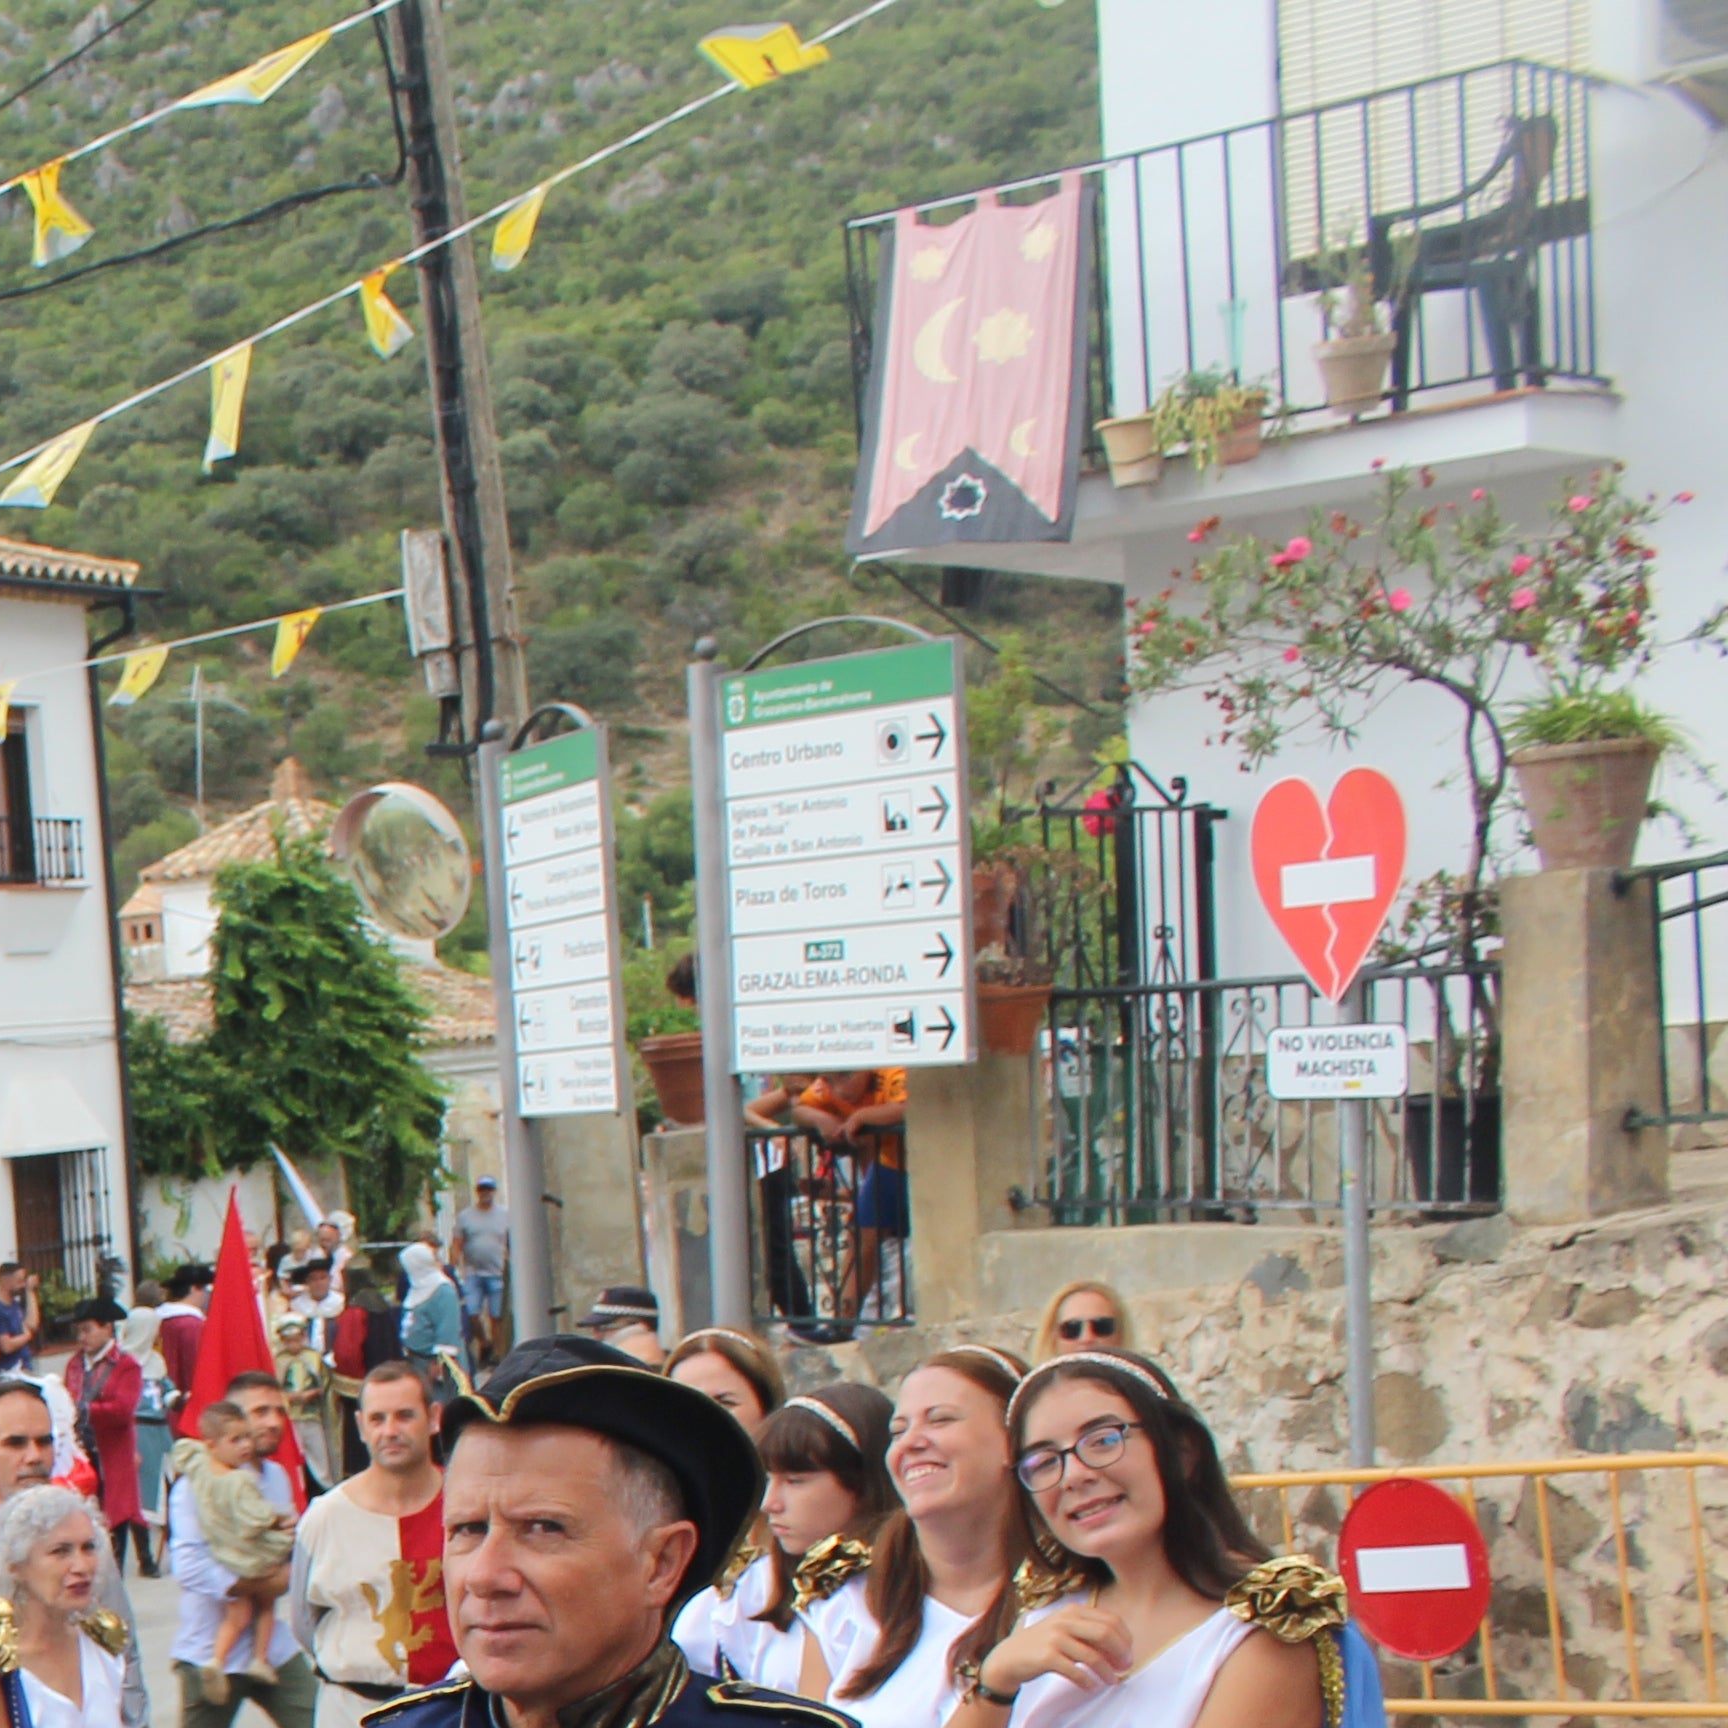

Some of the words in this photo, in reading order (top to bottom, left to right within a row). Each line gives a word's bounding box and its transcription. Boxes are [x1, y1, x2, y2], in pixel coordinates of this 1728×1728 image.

[729, 749, 783, 770] Centro
[786, 741, 844, 763] Urbano
[731, 806, 768, 823] Iglesia
[802, 797, 848, 812] Antonio
[732, 827, 746, 839] de
[734, 843, 771, 860] Capilla
[774, 841, 788, 854] de
[791, 838, 814, 852] San
[817, 834, 863, 849] Antonio
[735, 888, 776, 907] Plaza
[779, 885, 799, 902] de
[803, 881, 847, 900] Toros
[807, 943, 842, 960] A-372
[738, 965, 908, 993] GRAZALEMA-RONDA
[741, 1025, 770, 1038] Plaza
[772, 1023, 814, 1037] Mirador
[818, 1022, 838, 1034] Las
[840, 1019, 885, 1033] Huertas
[741, 1043, 770, 1056] Plaza
[772, 1042, 814, 1055] Mirador
[1278, 1034, 1305, 1053] NO
[1308, 1031, 1395, 1052] VIOLENCIA
[1295, 1057, 1377, 1077] MACHISTA
